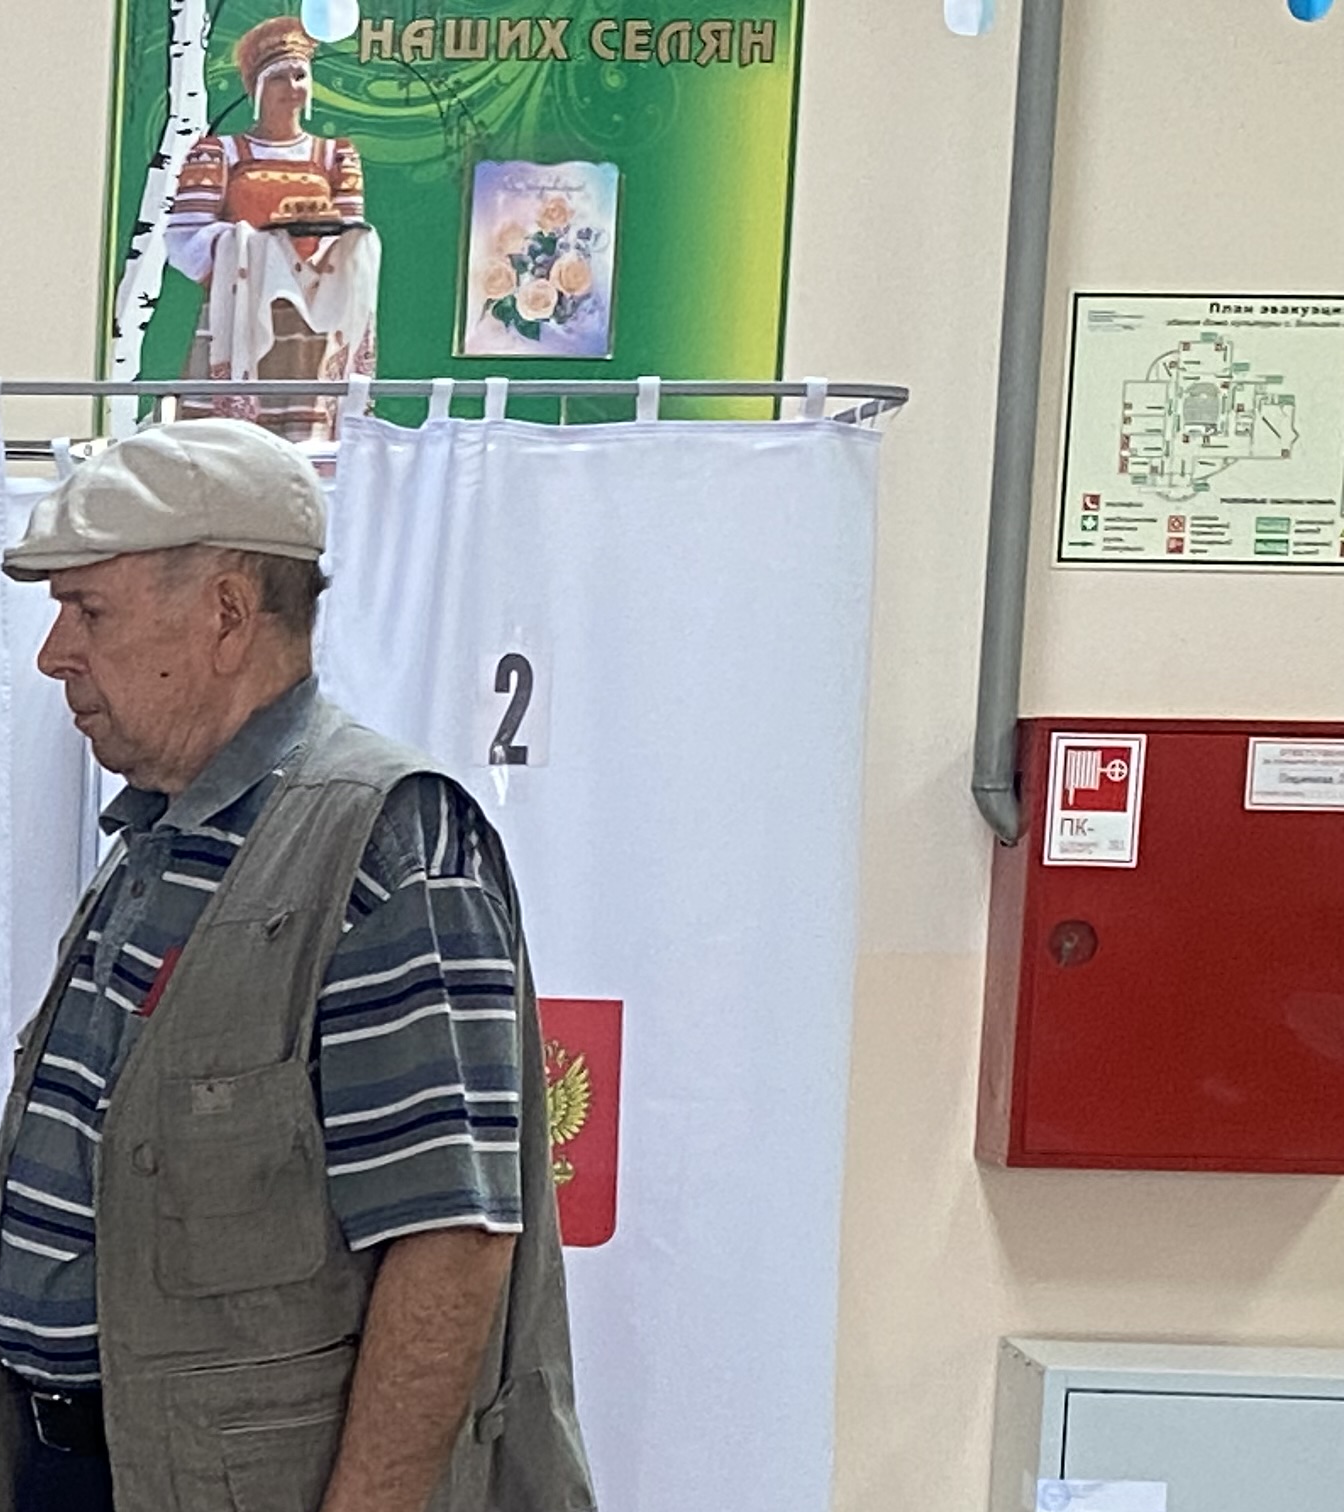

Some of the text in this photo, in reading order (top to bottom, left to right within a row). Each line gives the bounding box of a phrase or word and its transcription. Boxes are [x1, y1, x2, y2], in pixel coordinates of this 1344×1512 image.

[358, 16, 777, 67] НАШИХ СЕЛЯН
[1209, 302, 1254, 315] План
[489, 652, 534, 765] 2
